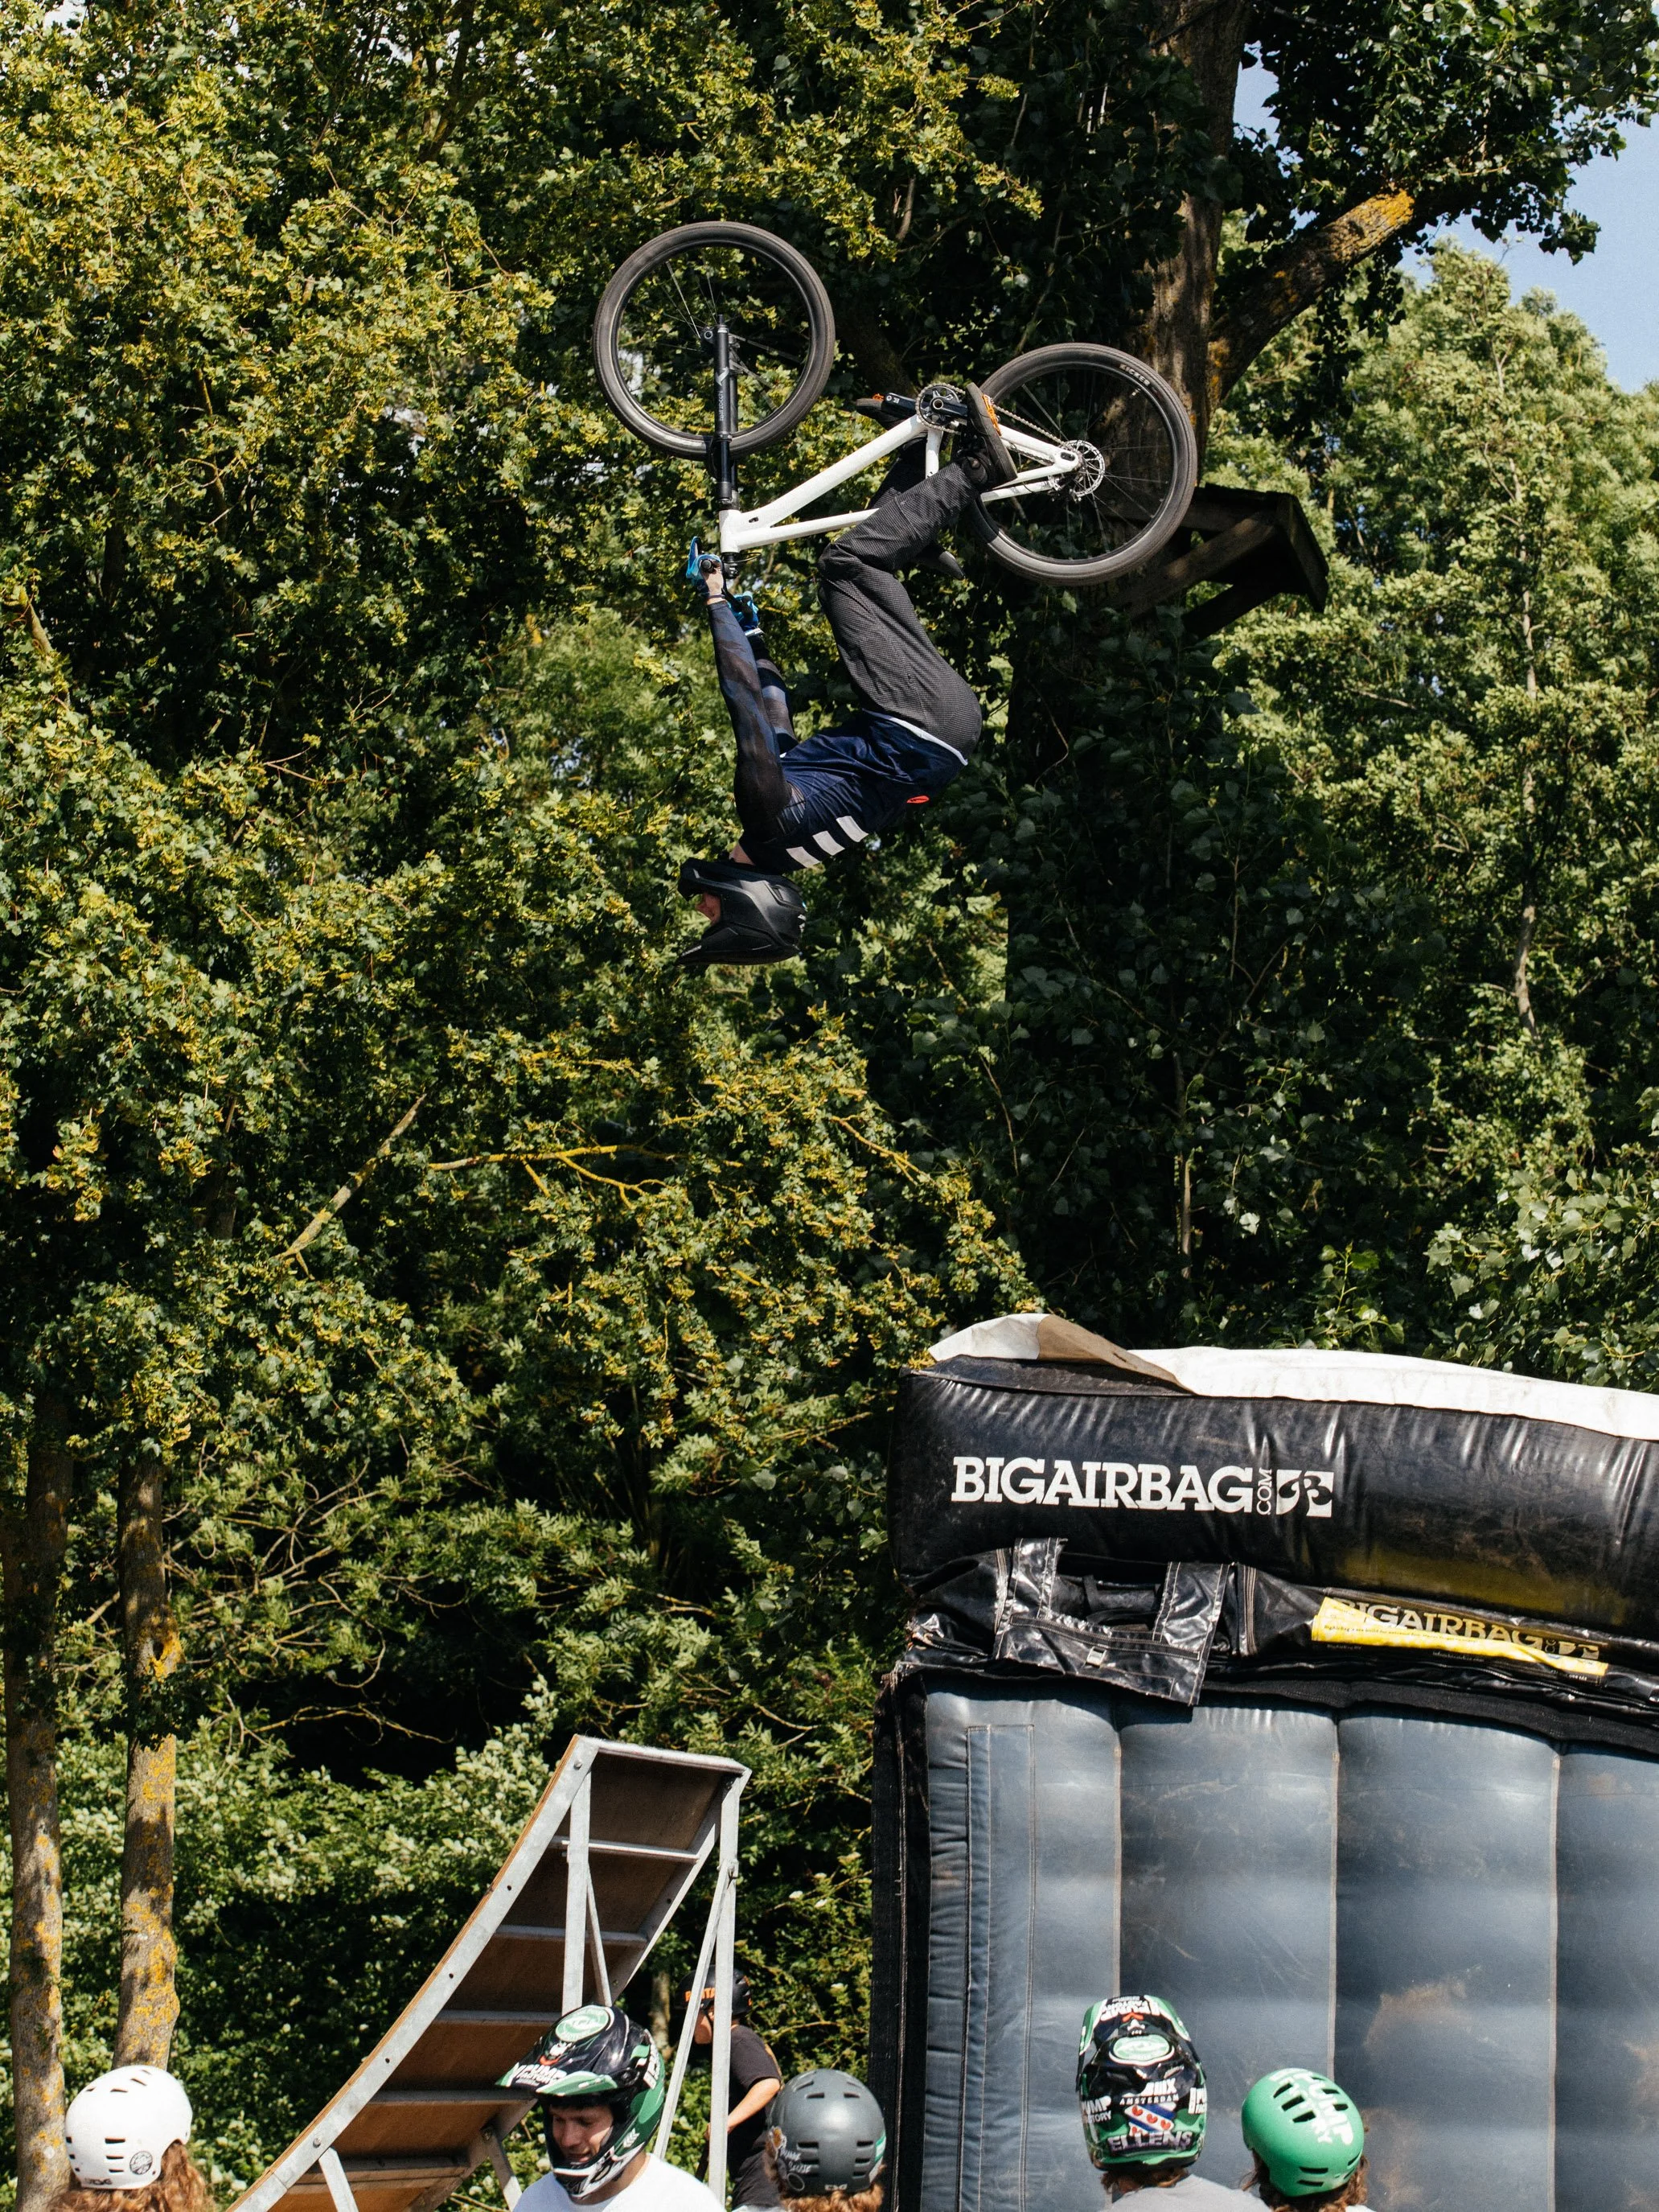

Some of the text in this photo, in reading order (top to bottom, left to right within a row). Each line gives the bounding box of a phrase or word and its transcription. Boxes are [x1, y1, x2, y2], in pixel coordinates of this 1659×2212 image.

[951, 1456, 1254, 1514] BIGAIRBAG
[1119, 2093, 1180, 2106] AMSTERDAM
[1107, 2130, 1193, 2152] ELLENS
